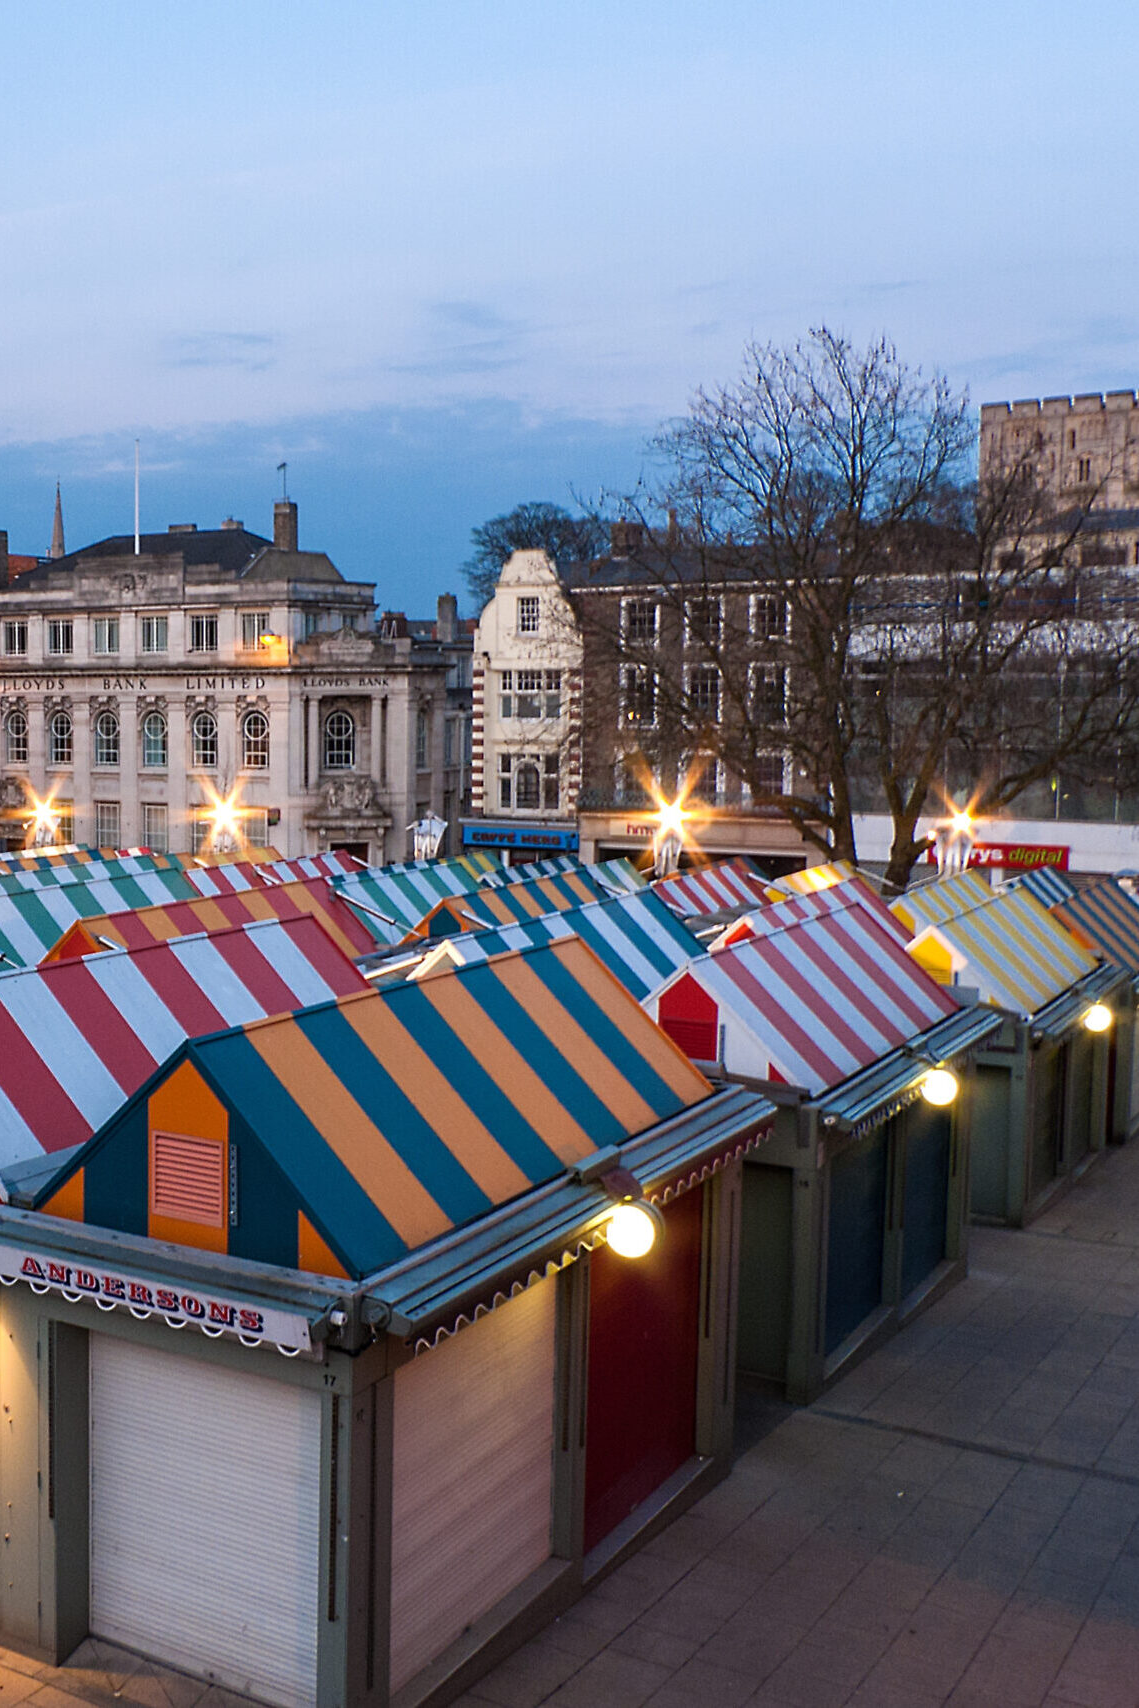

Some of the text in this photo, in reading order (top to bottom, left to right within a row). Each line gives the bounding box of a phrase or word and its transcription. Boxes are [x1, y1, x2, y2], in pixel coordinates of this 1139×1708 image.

[3, 677, 266, 692] LLOYDS BANK LIMITED
[303, 678, 390, 688] LLOYDS BANK
[1008, 848, 1064, 865] digital
[20, 1256, 264, 1333] ANDERSONS
[323, 1374, 336, 1386] 17
